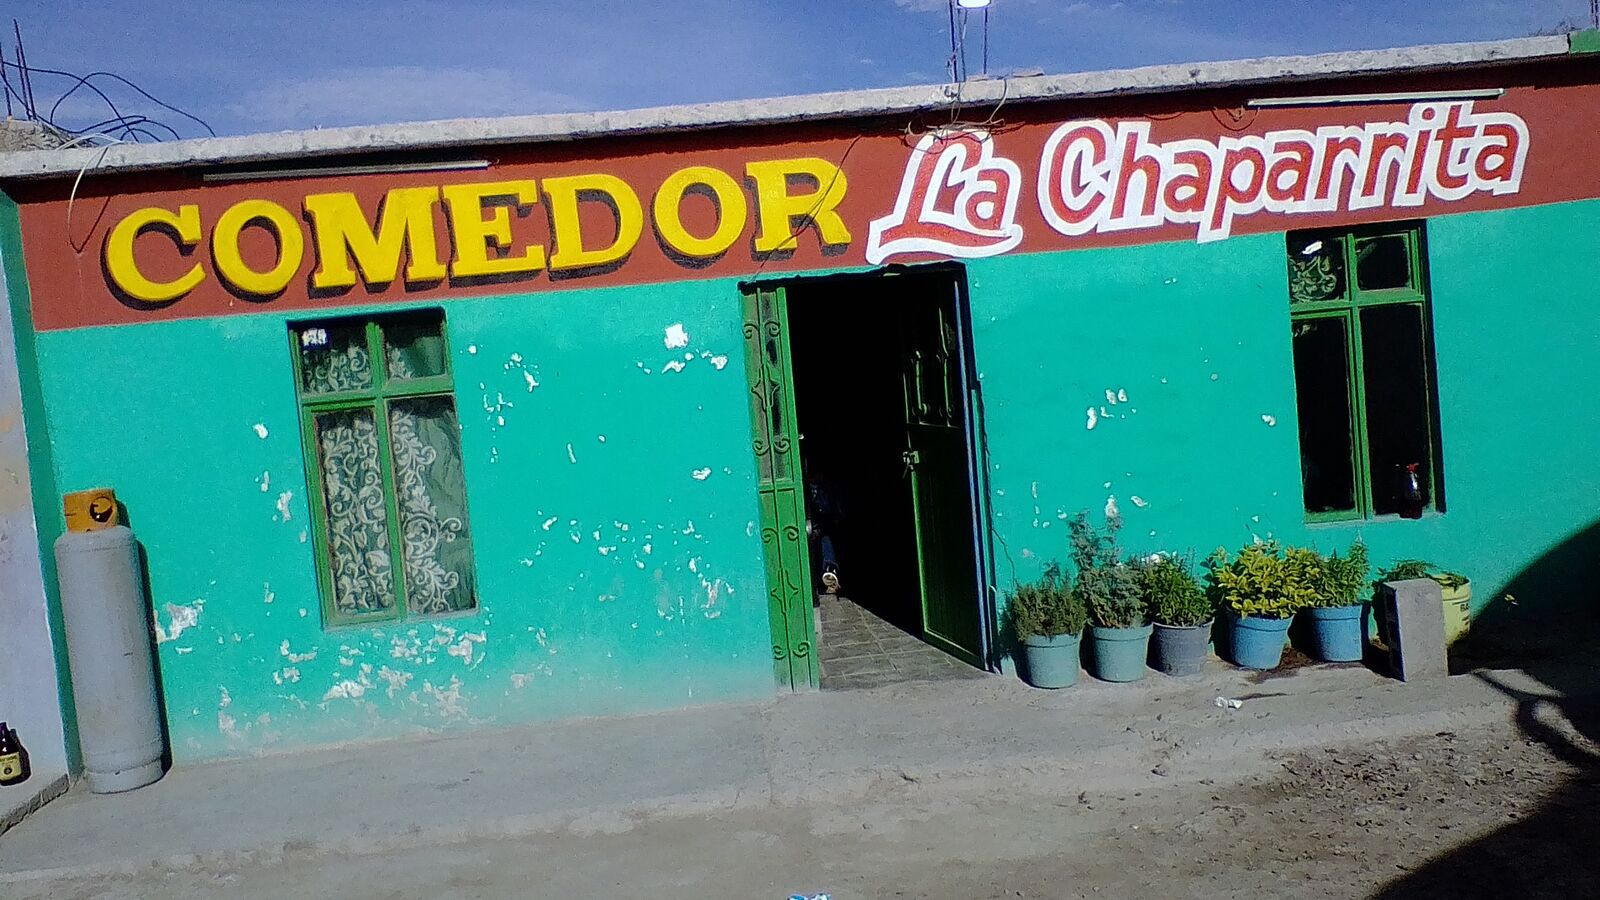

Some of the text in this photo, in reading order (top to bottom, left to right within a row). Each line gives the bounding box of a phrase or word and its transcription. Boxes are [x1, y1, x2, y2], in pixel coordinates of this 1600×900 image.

[105, 101, 1530, 305] COMEDOR La Chaparrita
